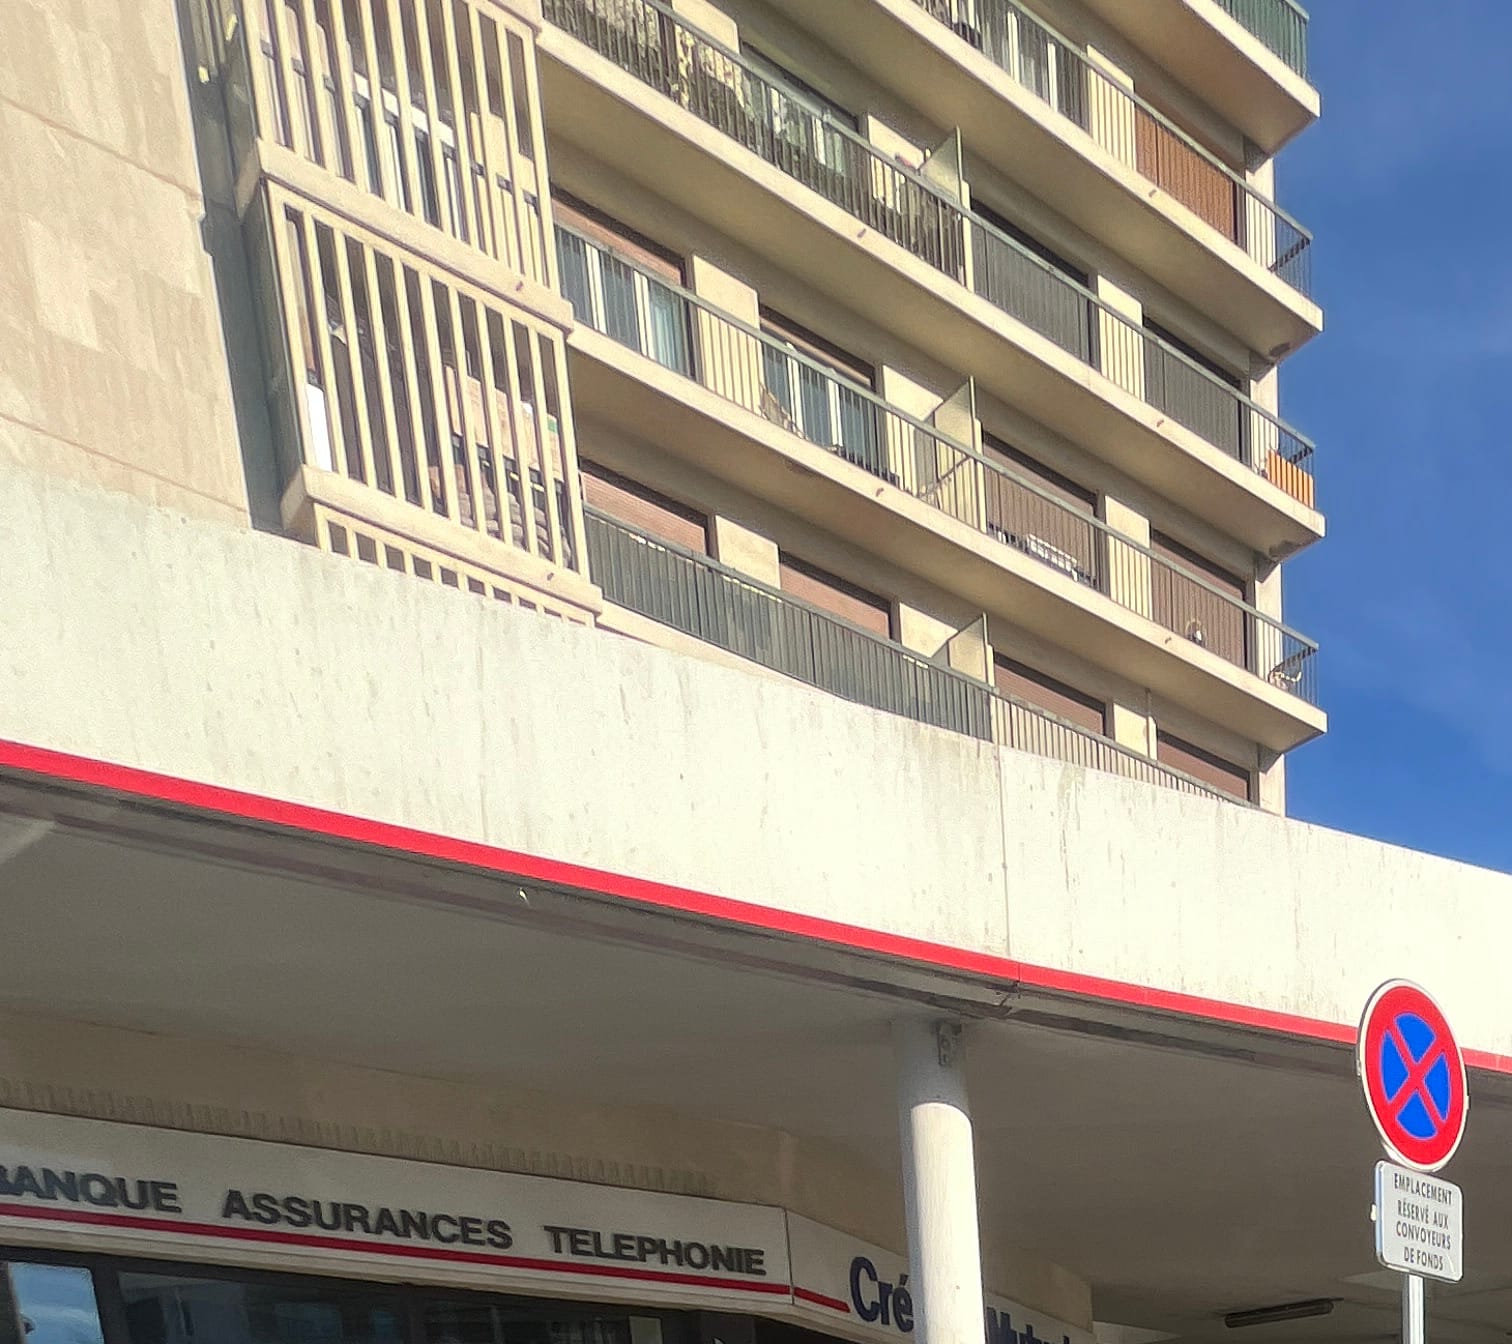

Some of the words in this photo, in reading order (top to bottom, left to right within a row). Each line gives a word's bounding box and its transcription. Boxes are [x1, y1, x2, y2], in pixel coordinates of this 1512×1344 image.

[1394, 1172, 1453, 1206] EMPLACEMENT
[222, 1189, 513, 1250] ASSURANCES
[544, 1225, 767, 1277] TELEPHONIE
[1396, 1220, 1452, 1250] CONVOYEURS
[1432, 1210, 1449, 1230] AUX
[1403, 1246, 1415, 1263] DE
[1416, 1250, 1444, 1271] FONDS
